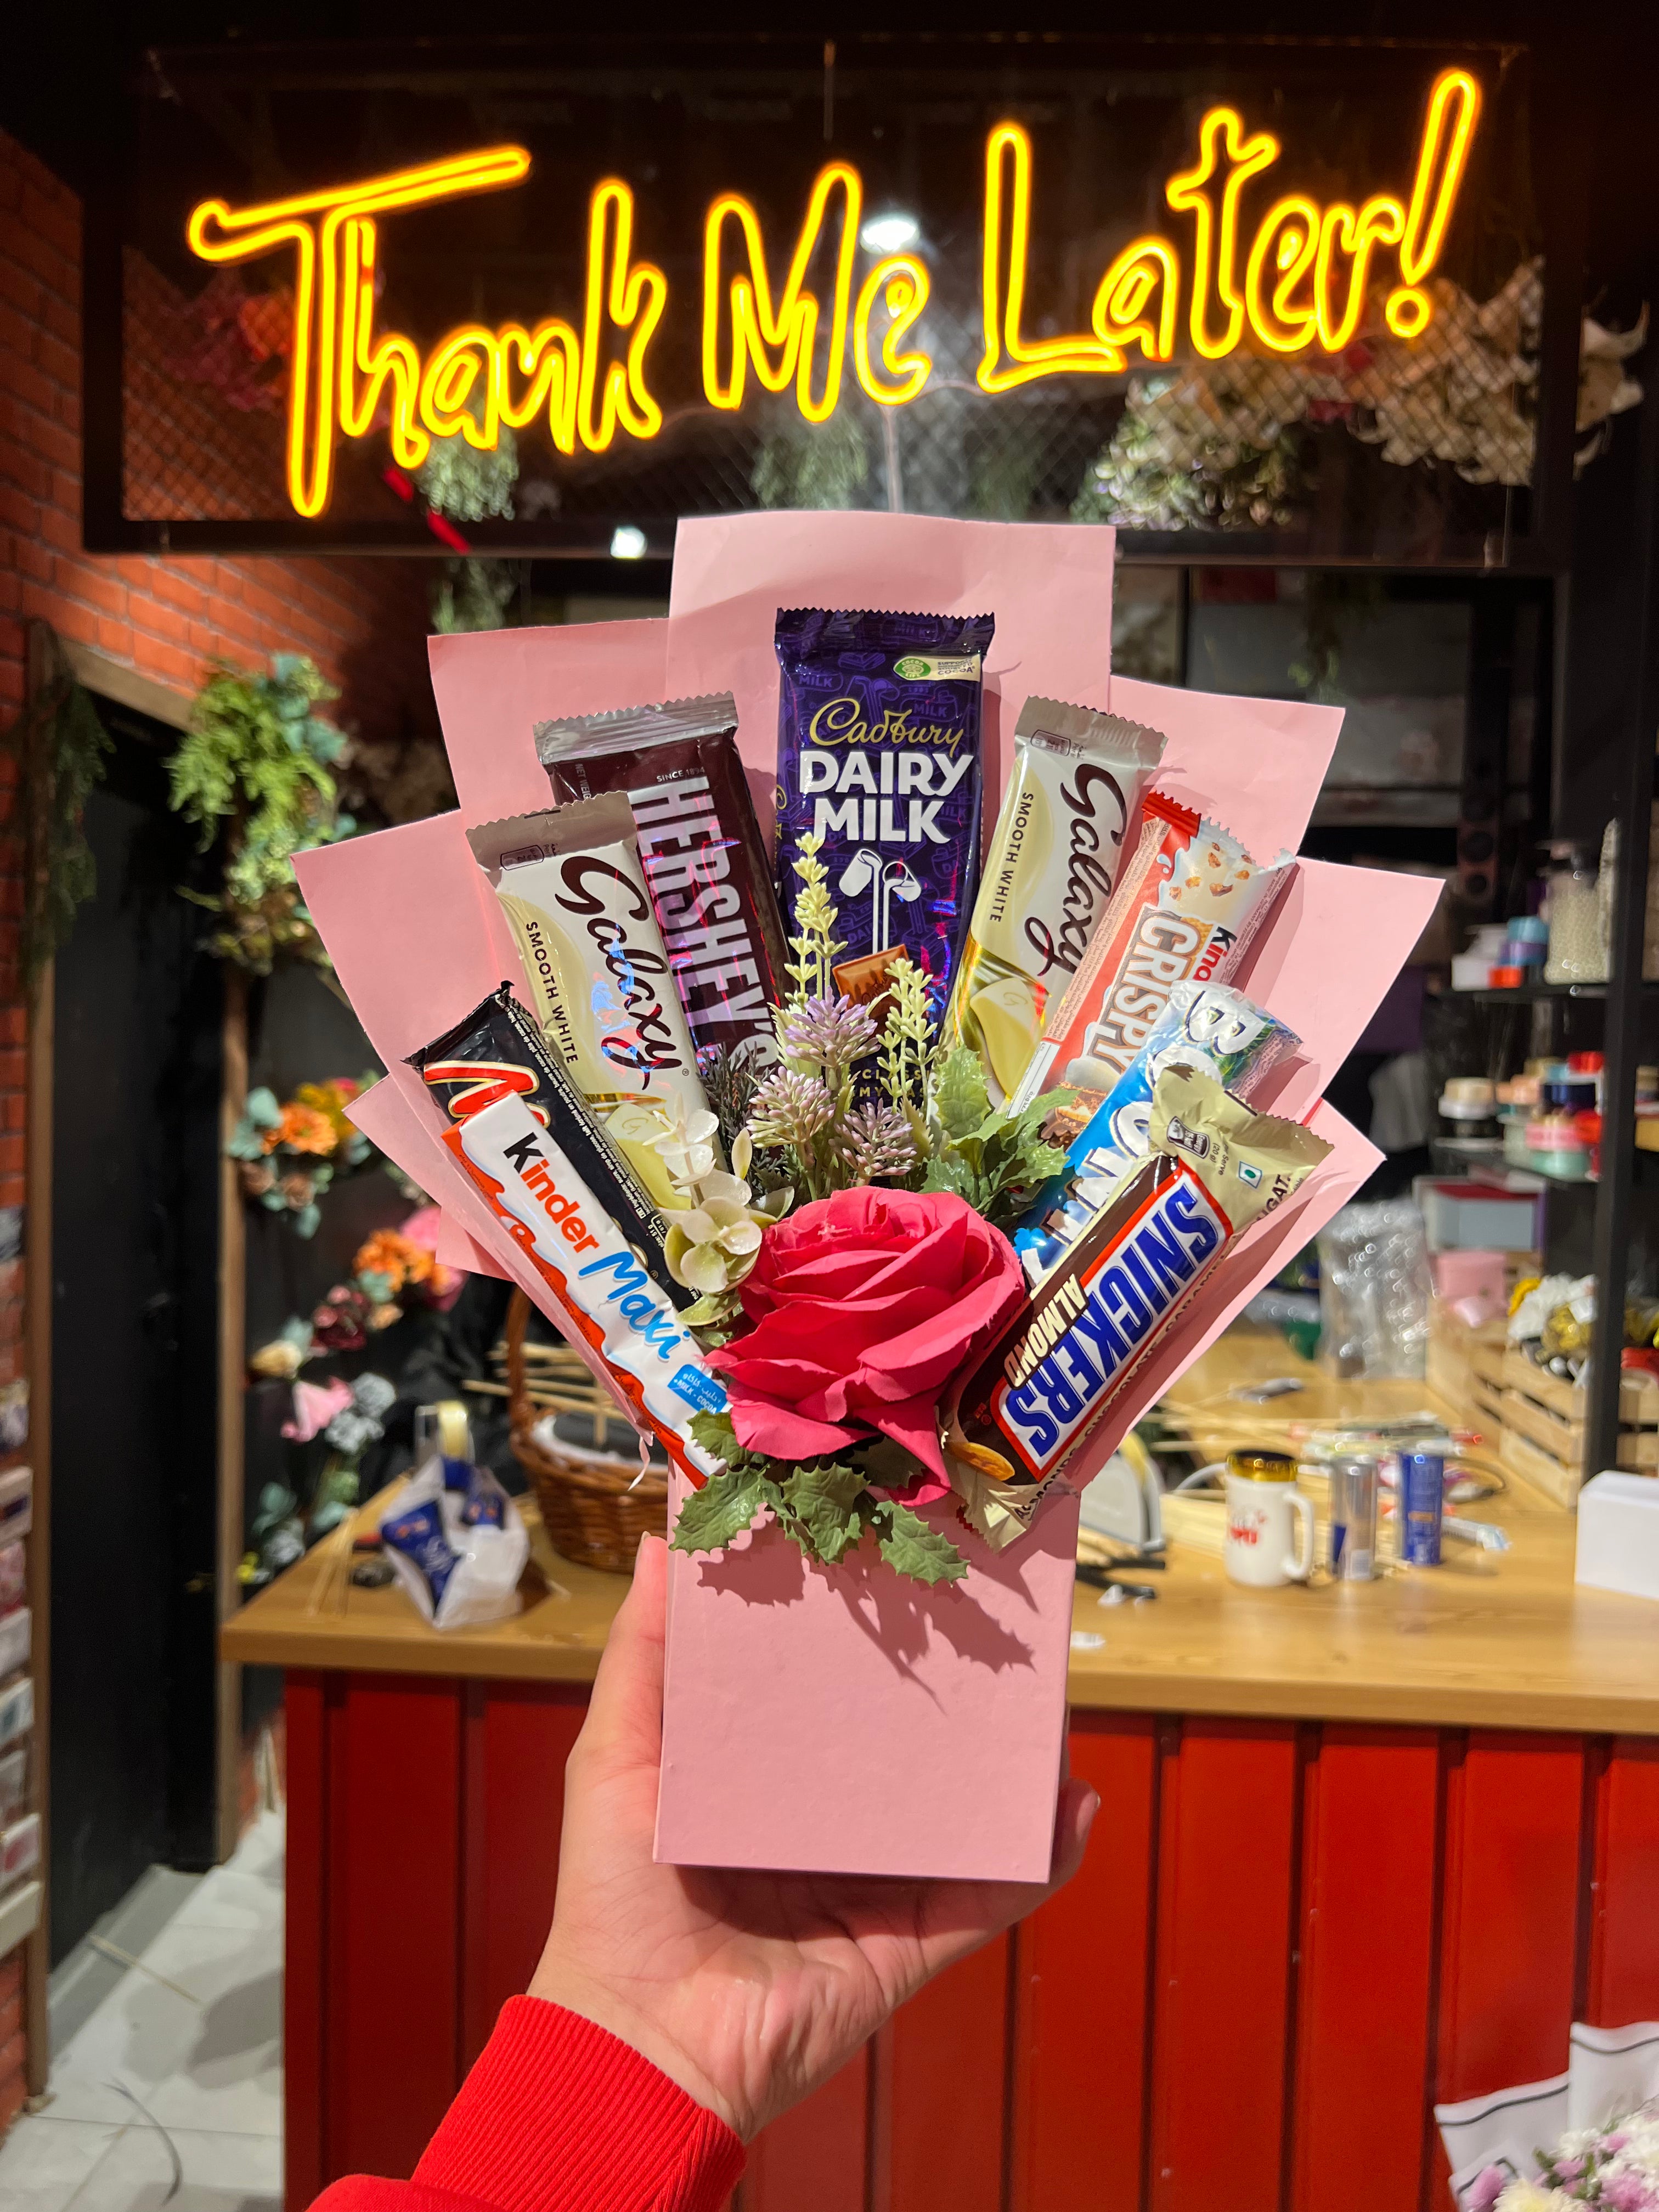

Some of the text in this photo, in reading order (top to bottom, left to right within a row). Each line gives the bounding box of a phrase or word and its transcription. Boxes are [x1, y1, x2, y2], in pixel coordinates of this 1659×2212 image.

[187, 67, 1482, 519] Thank Me Later!
[656, 766, 706, 782] SINCE 1894
[799, 750, 974, 797] DAIRY
[809, 697, 964, 758] Cadbury
[813, 798, 951, 844] MILK
[989, 792, 1034, 923] SMOOTH WHITE
[1024, 763, 1127, 977] Galaxy
[526, 922, 560, 1000] SMOOTH
[552, 1004, 579, 1064] WHITE
[555, 856, 682, 1091] Galaxy
[1094, 914, 1201, 1073] CRISPY
[503, 1131, 600, 1254] Kinder
[1217, 1154, 1229, 1176] Serve
[1003, 1274, 1088, 1389] ALMOND
[1006, 1183, 1218, 1458] SNICKERS
